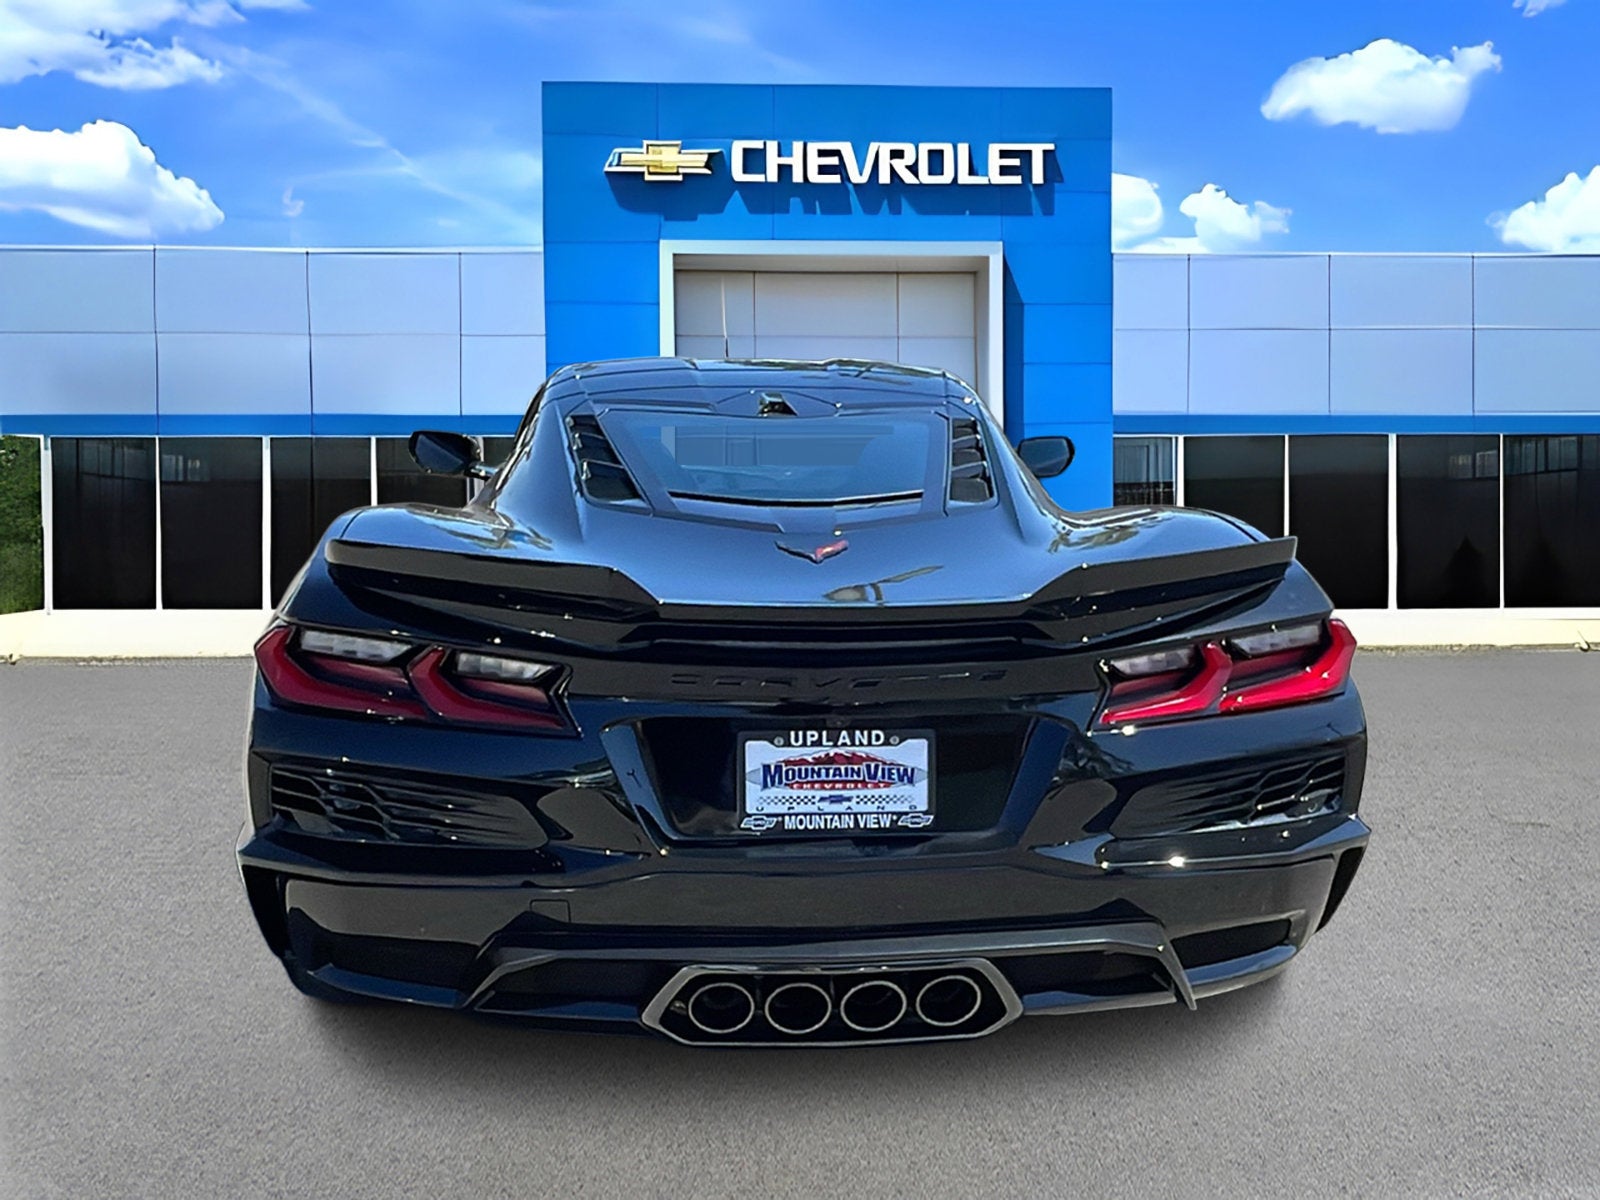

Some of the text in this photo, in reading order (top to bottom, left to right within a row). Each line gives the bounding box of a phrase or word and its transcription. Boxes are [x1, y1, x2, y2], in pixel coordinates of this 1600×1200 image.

[731, 140, 1055, 185] CHEVROLET
[789, 730, 885, 746] UPLAND
[784, 814, 854, 830] MOUNTAIN
[859, 814, 892, 828] VIEW
